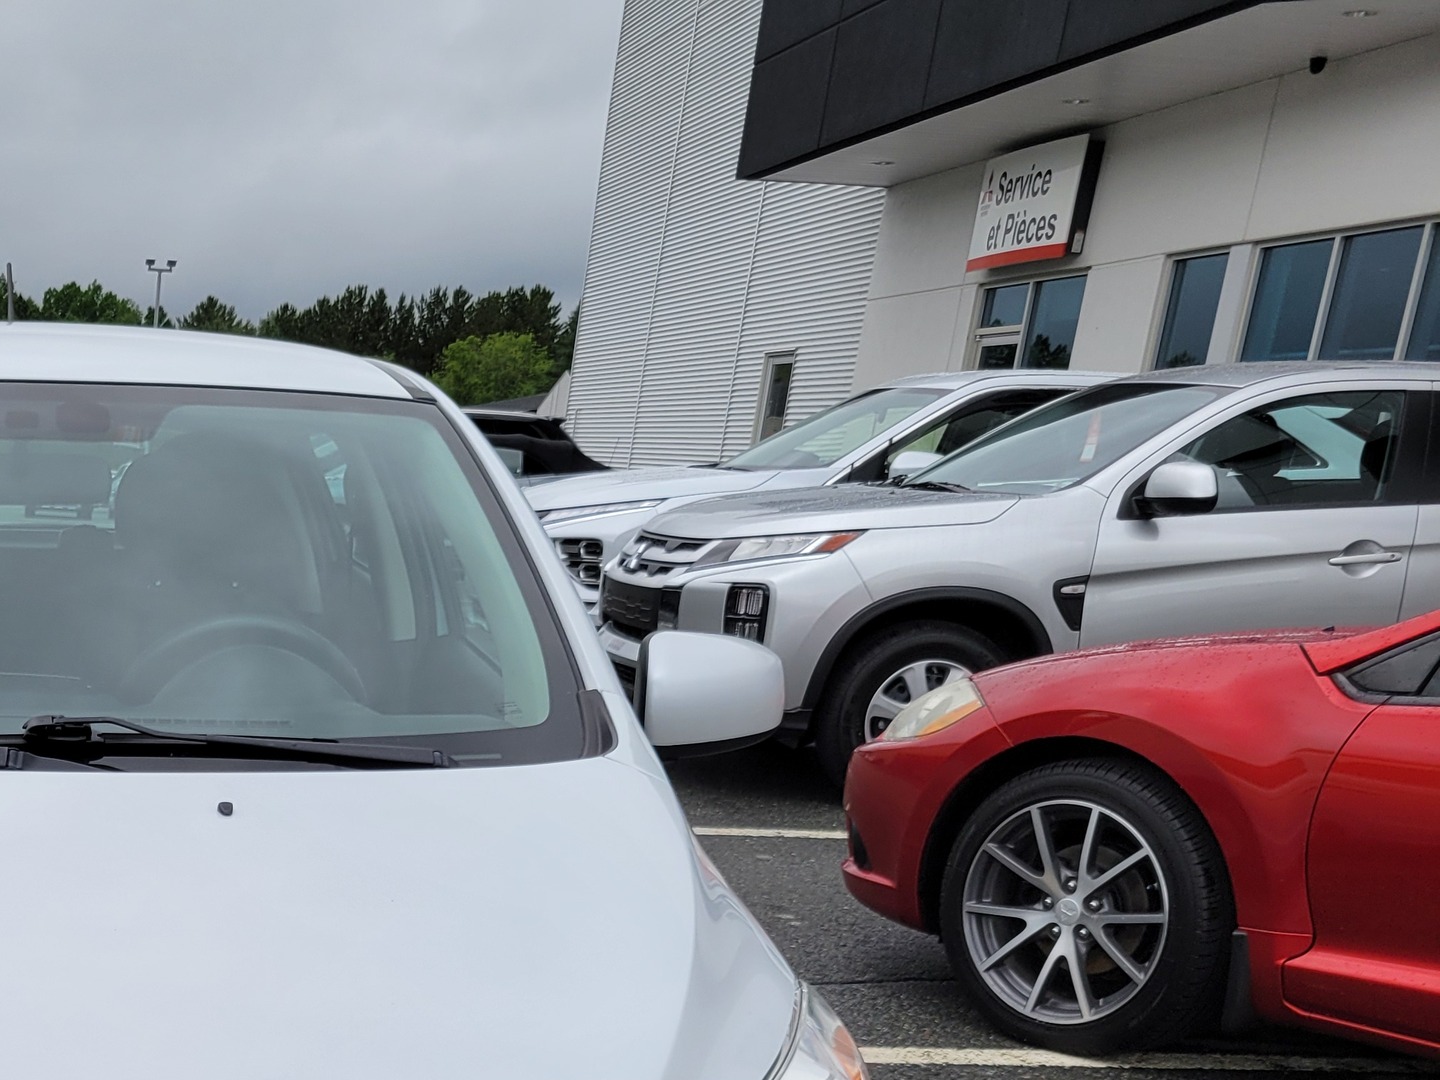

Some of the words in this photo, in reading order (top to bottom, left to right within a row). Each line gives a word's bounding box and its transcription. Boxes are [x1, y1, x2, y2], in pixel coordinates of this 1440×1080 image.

[995, 164, 1052, 206] Service
[986, 217, 1002, 251] et
[1001, 210, 1058, 248] Pièces
